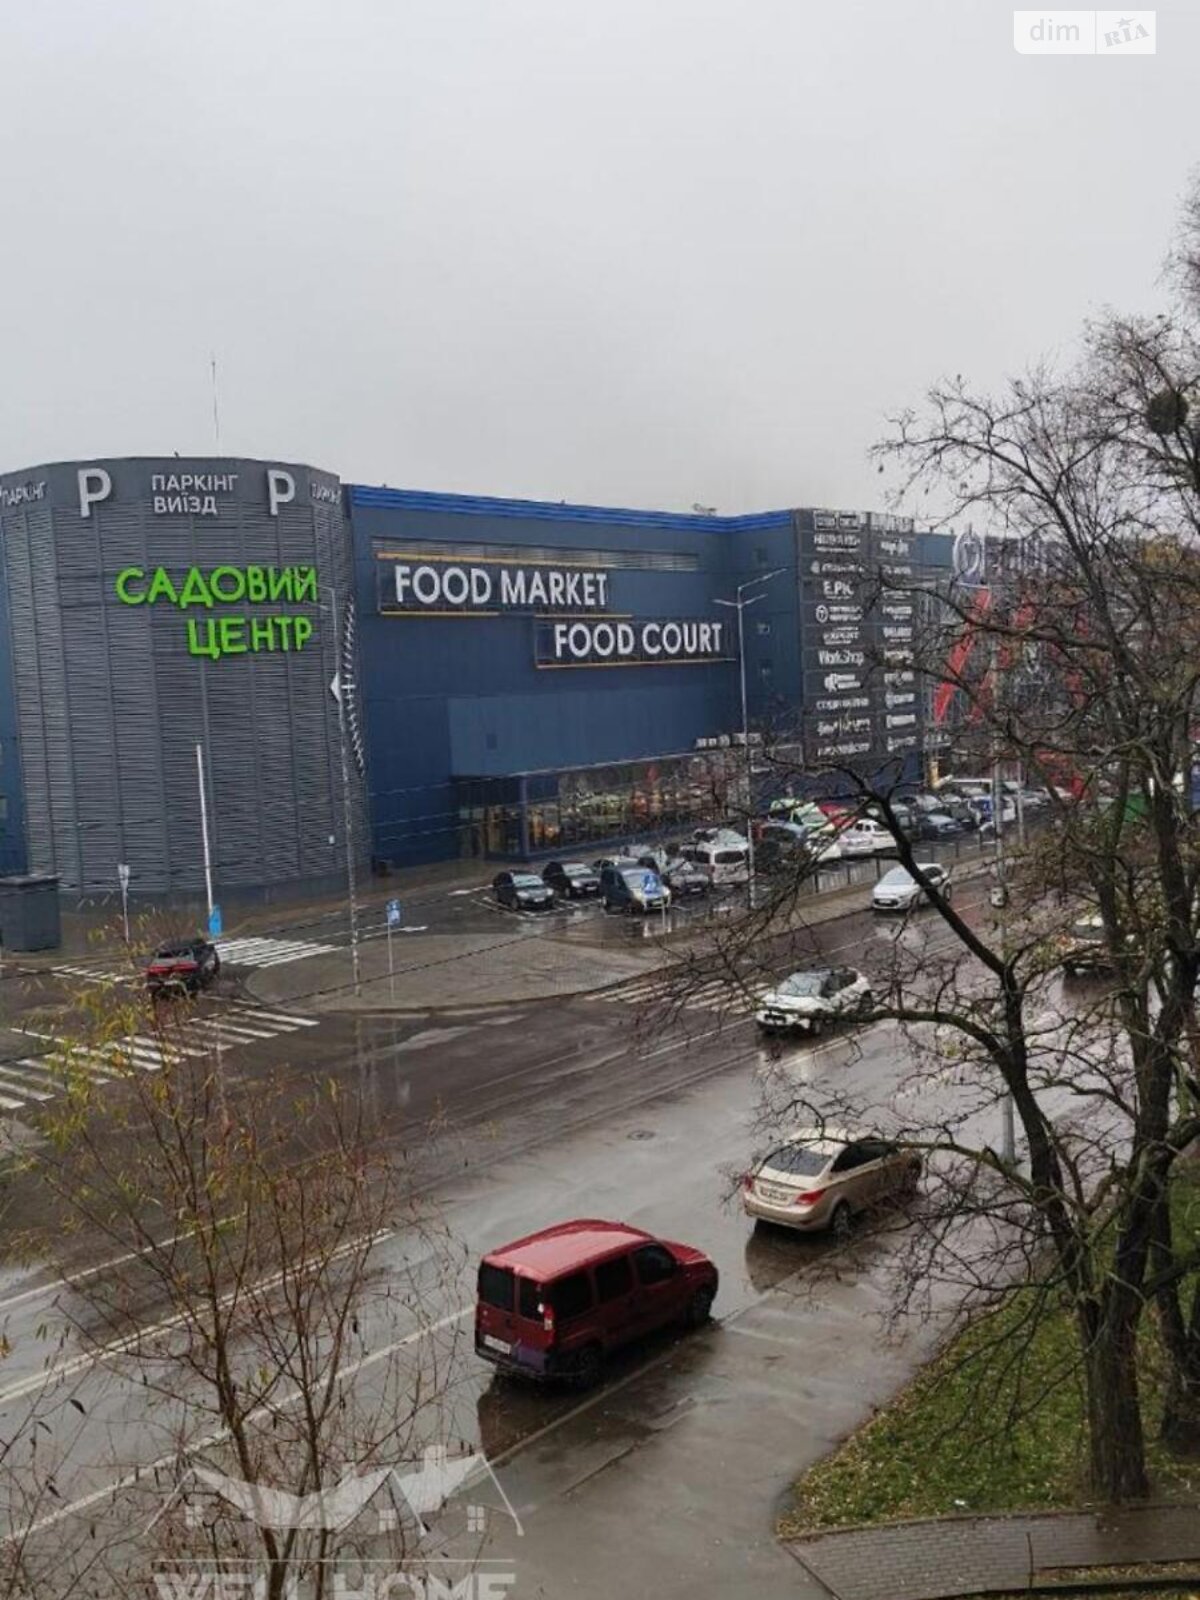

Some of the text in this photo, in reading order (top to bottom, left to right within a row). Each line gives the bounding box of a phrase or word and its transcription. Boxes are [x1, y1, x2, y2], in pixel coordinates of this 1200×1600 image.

[151, 474, 239, 493] ПАРКІНГ
[153, 495, 218, 515] ВИЇЗД
[115, 565, 318, 610] САДОВИЙ
[395, 564, 608, 606] FOOD MARKET
[187, 615, 313, 660] ЦЕНТР
[555, 622, 723, 658] FOOD COURT
